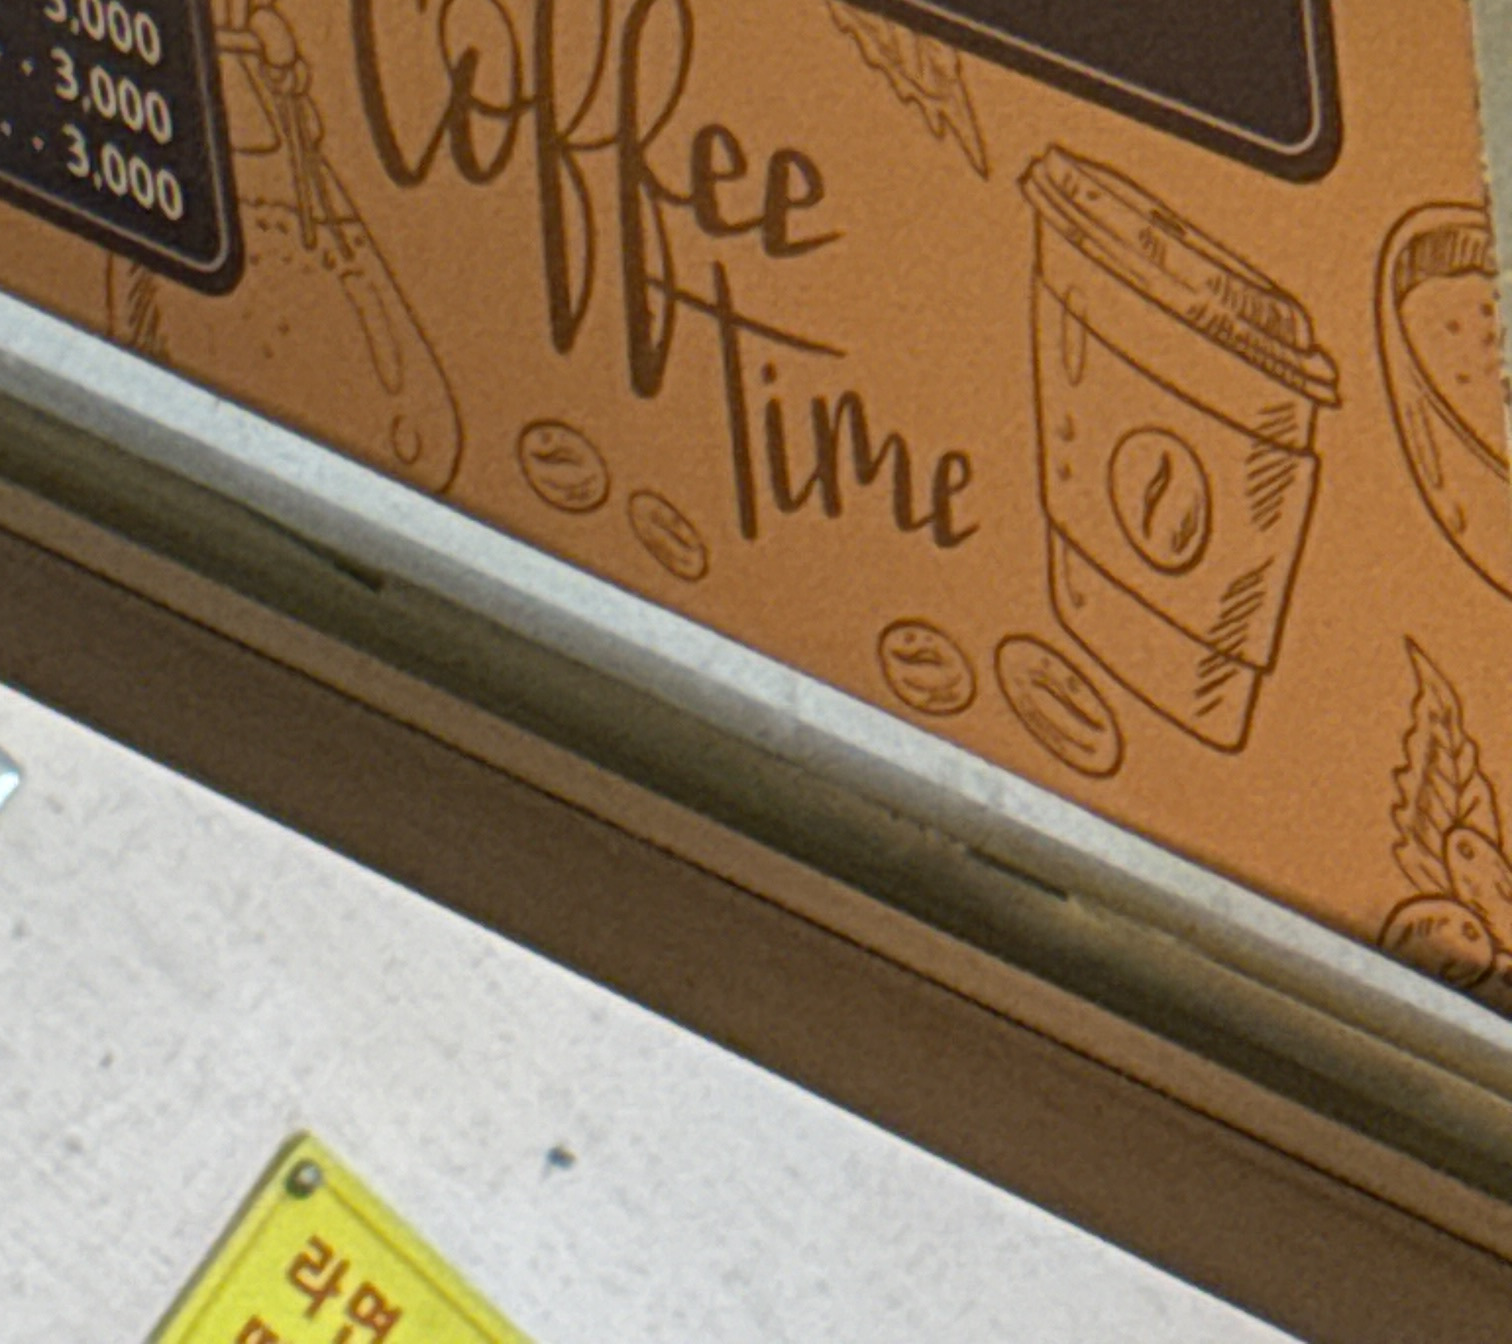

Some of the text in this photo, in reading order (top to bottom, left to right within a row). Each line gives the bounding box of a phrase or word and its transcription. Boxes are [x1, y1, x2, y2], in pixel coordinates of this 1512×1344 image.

[53, 48, 171, 143] 3,000
[64, 125, 182, 219] 3,000
[648, 262, 980, 549] Time
